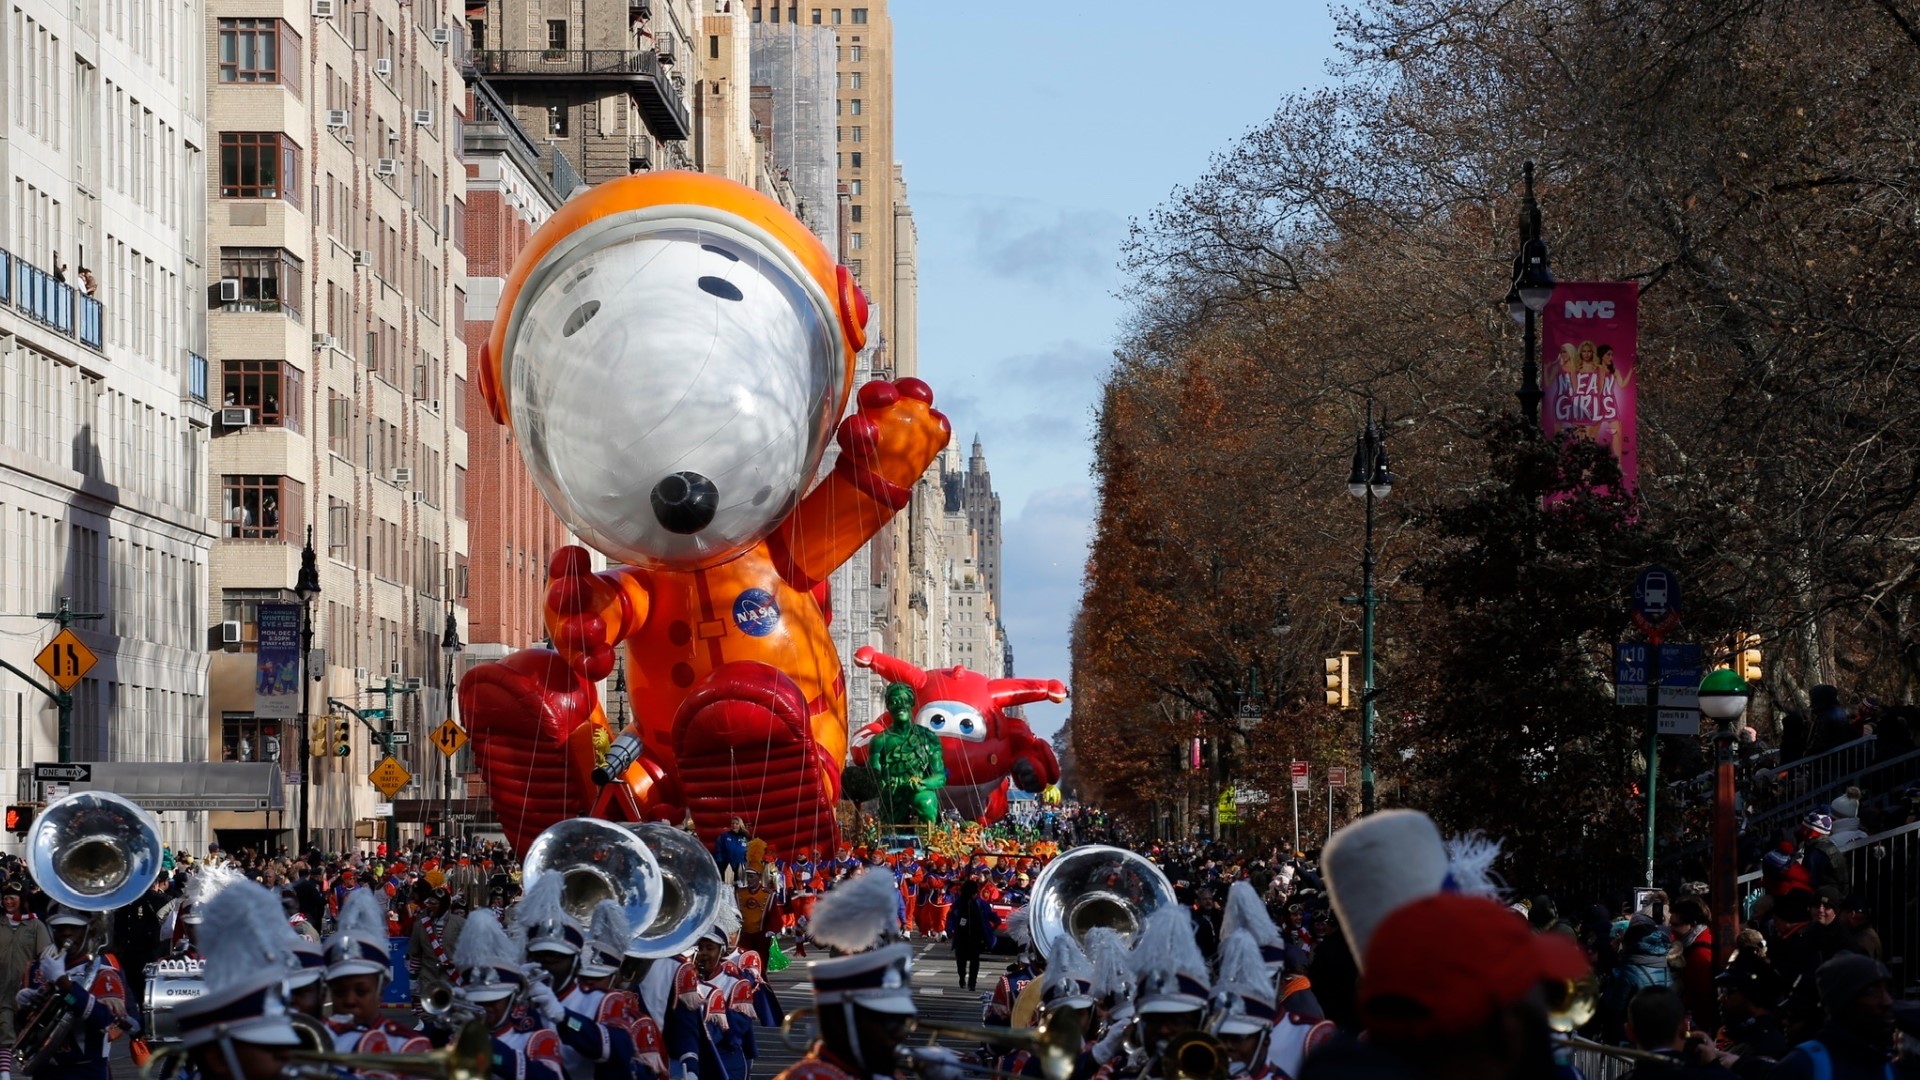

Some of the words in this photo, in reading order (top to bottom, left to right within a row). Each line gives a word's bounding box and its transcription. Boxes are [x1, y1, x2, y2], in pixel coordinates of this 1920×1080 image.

[1565, 300, 1615, 318] NYC
[1559, 373, 1614, 396] MEAN
[1556, 395, 1616, 421] GIRLS
[736, 606, 777, 623] NASA
[1619, 646, 1645, 663] M10
[1619, 666, 1645, 682] M20
[42, 768, 59, 776] ONE
[65, 769, 83, 777] WAY
